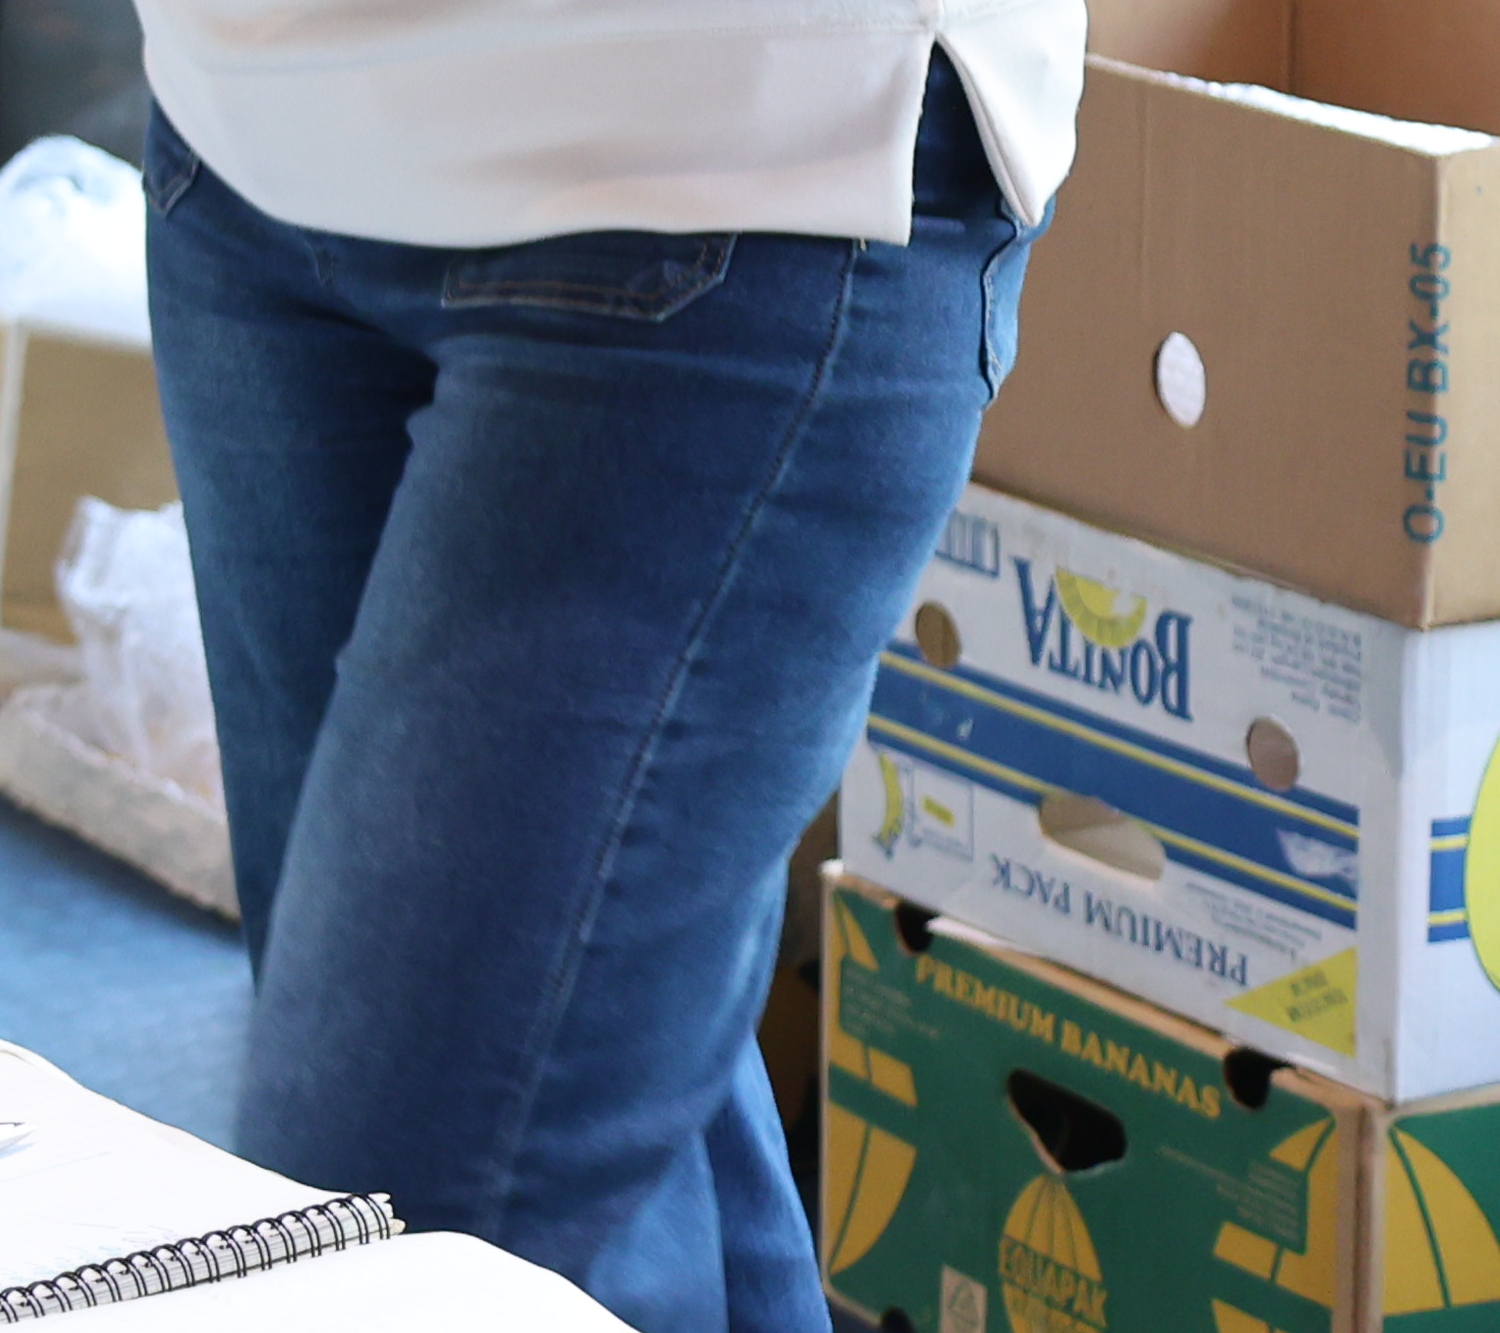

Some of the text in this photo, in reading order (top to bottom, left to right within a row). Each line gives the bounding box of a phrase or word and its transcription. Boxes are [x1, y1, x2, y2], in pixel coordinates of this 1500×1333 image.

[1408, 242, 1452, 393] BX-05
[1012, 555, 1193, 723] BONITA
[987, 850, 1071, 914] PACK
[1083, 890, 1248, 986] PREMIUM
[914, 955, 1058, 1044] PREMIUM
[1058, 1015, 1223, 1121] BANANAS
